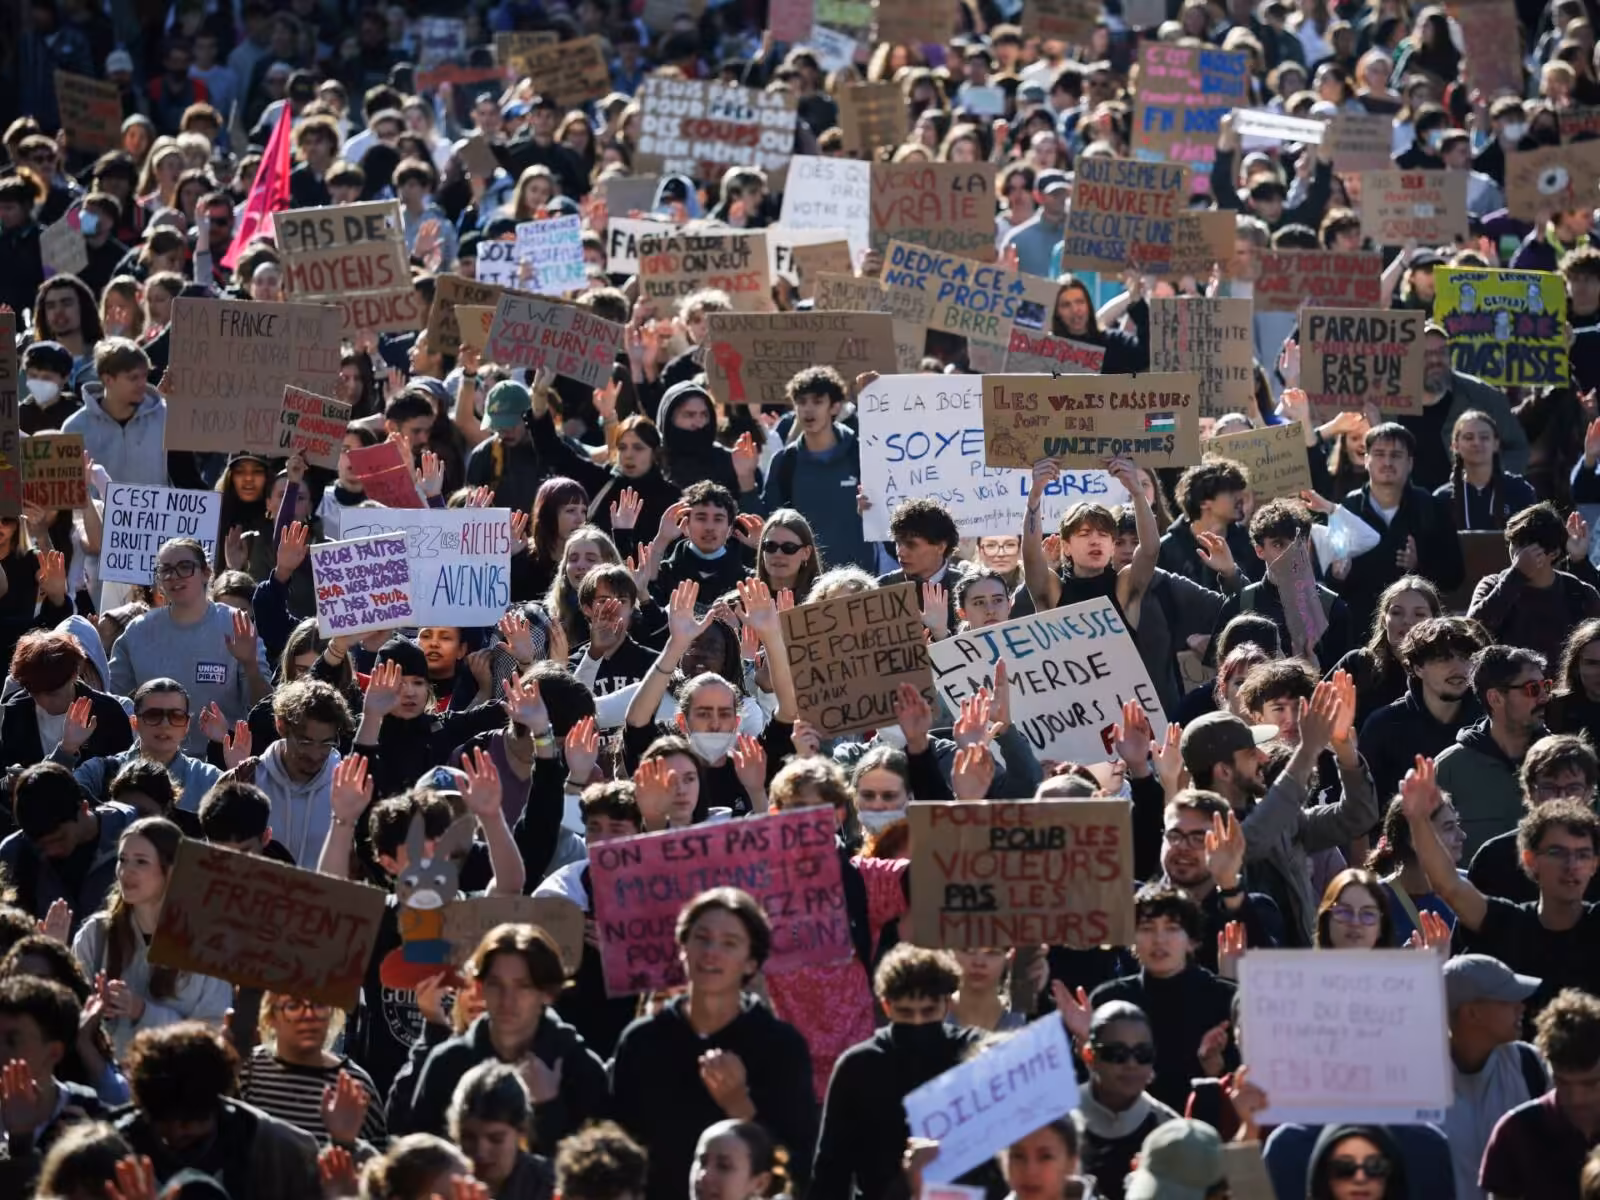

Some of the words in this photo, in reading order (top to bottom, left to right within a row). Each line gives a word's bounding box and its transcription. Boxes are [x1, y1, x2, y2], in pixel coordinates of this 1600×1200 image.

[952, 173, 987, 193] LA
[1079, 157, 1110, 184] QUI
[1162, 168, 1182, 191] LA
[873, 192, 978, 228] VRAIE
[1078, 183, 1177, 218] PAUVRETÉ
[281, 217, 335, 254] PAS
[343, 214, 386, 242] DE
[1145, 220, 1175, 243] UNE
[286, 254, 394, 292] MOYENS
[682, 254, 709, 273] ON
[710, 252, 753, 271] VEUT
[937, 281, 1018, 319] PROFS
[174, 305, 210, 338] MA
[219, 308, 279, 338] FRANCE
[501, 297, 519, 316] IF
[528, 303, 564, 326] WE
[570, 311, 620, 345] BURN
[943, 306, 1000, 336] BRRR
[497, 318, 539, 342] YOU
[541, 328, 588, 357] BURN
[1322, 354, 1367, 375] PAS
[1373, 355, 1401, 379] UN
[867, 393, 889, 413] DE
[903, 394, 926, 413] LA
[993, 385, 1038, 411] LES
[1109, 390, 1191, 411] CASSEURS
[1064, 415, 1094, 432] EN
[1043, 433, 1176, 459] UNIFORMES
[885, 469, 897, 493] À
[910, 465, 939, 486] NE
[1020, 474, 1109, 498] LBRES
[112, 487, 160, 509] C'EST
[166, 492, 208, 515] NOUS
[112, 509, 132, 529] ON
[137, 511, 171, 532] FAIT
[177, 516, 198, 536] DU
[110, 531, 152, 552] BRUIT
[354, 538, 407, 564] FAITES
[106, 552, 134, 571] QUE
[317, 583, 345, 601] SUR
[369, 588, 409, 607] POUR
[788, 604, 838, 641] LES
[846, 589, 912, 627] FEUX
[786, 640, 822, 666] DE
[829, 621, 923, 658] POUBELLE
[929, 639, 982, 679] LA
[974, 607, 1125, 666] JEUNESSE
[198, 664, 227, 673] UNION
[874, 643, 930, 673] PEUR
[198, 673, 226, 682] PIRATE
[1022, 699, 1105, 750] UJOURS
[931, 803, 1035, 828] POLICE
[598, 846, 642, 872] ON
[661, 835, 713, 861] EST
[723, 826, 770, 854] PAS
[781, 819, 830, 850] DES
[1074, 824, 1119, 847] LES
[931, 849, 1121, 885] VIOLEURS
[945, 882, 998, 908] PAS
[1008, 884, 1067, 909] LES
[939, 910, 1110, 949] MINEURS
[921, 1044, 1062, 1142] DILEMME
